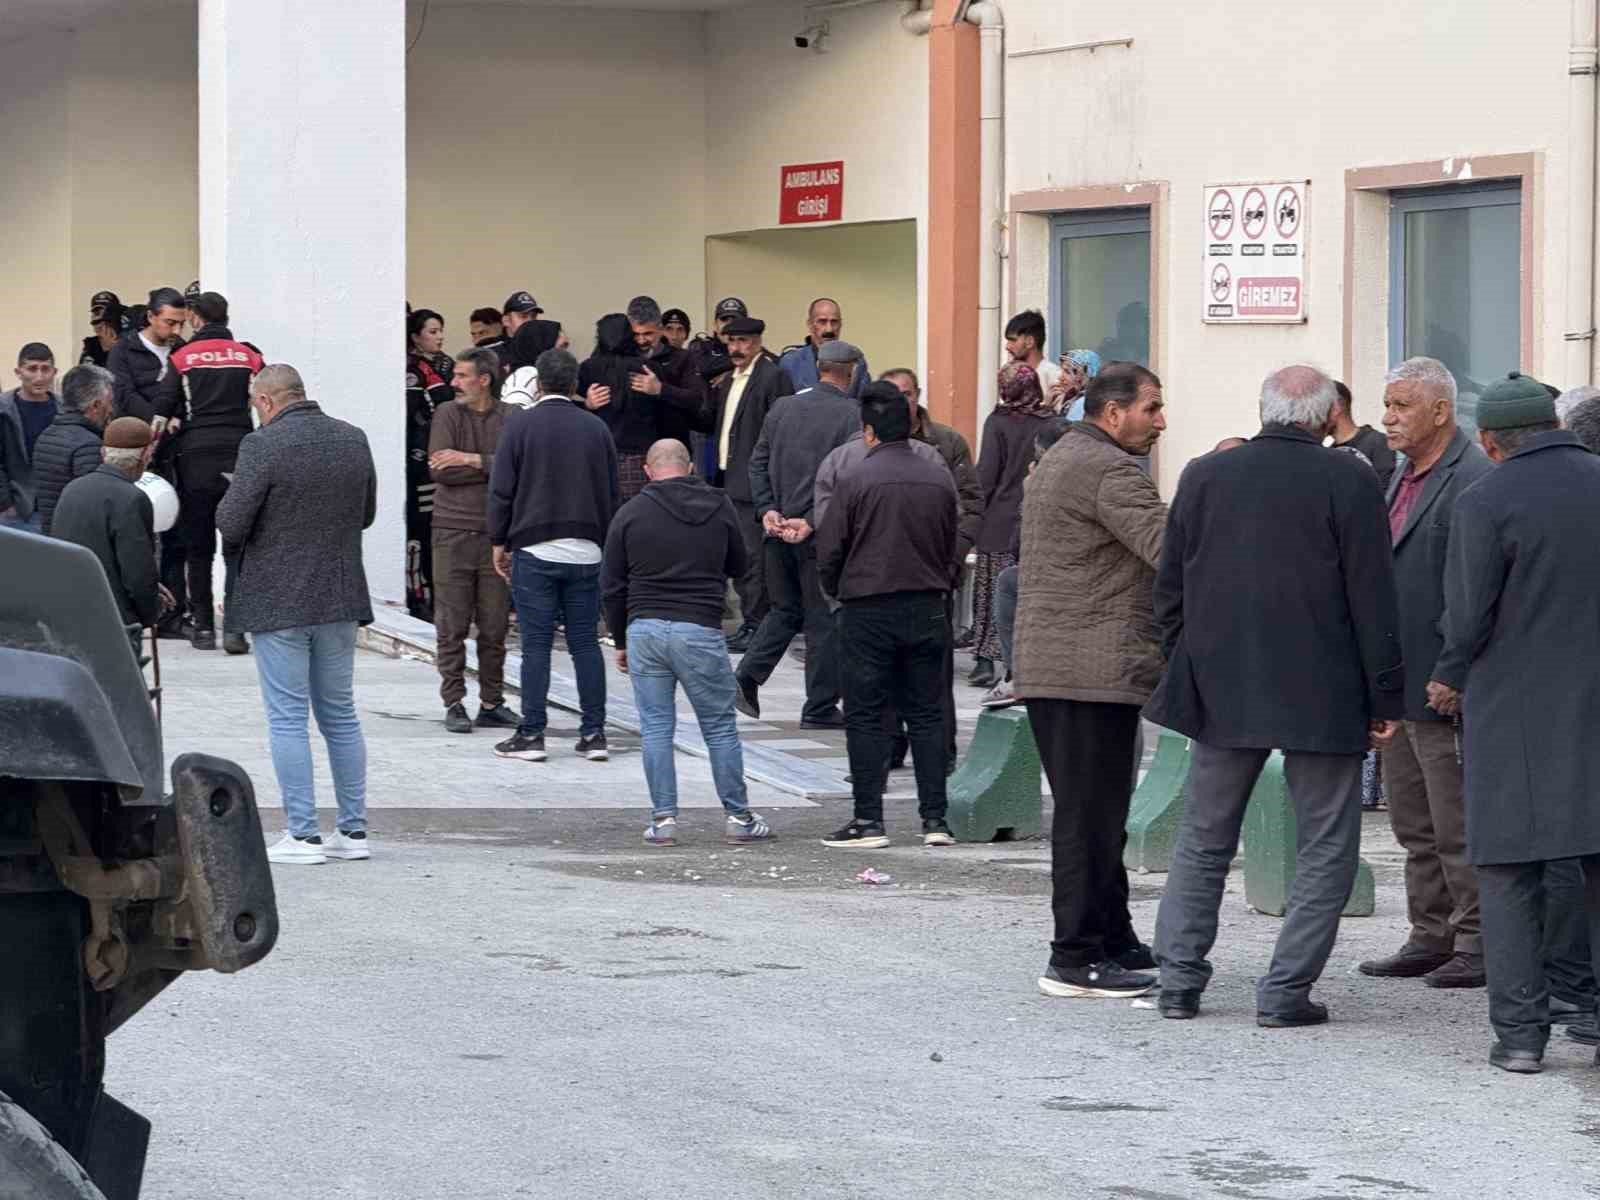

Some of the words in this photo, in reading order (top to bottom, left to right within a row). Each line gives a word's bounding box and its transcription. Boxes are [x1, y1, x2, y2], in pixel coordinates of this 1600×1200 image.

[784, 168, 840, 189] AMBULANS
[1239, 280, 1297, 307] GİREMEZ
[185, 348, 249, 365] POLİS
